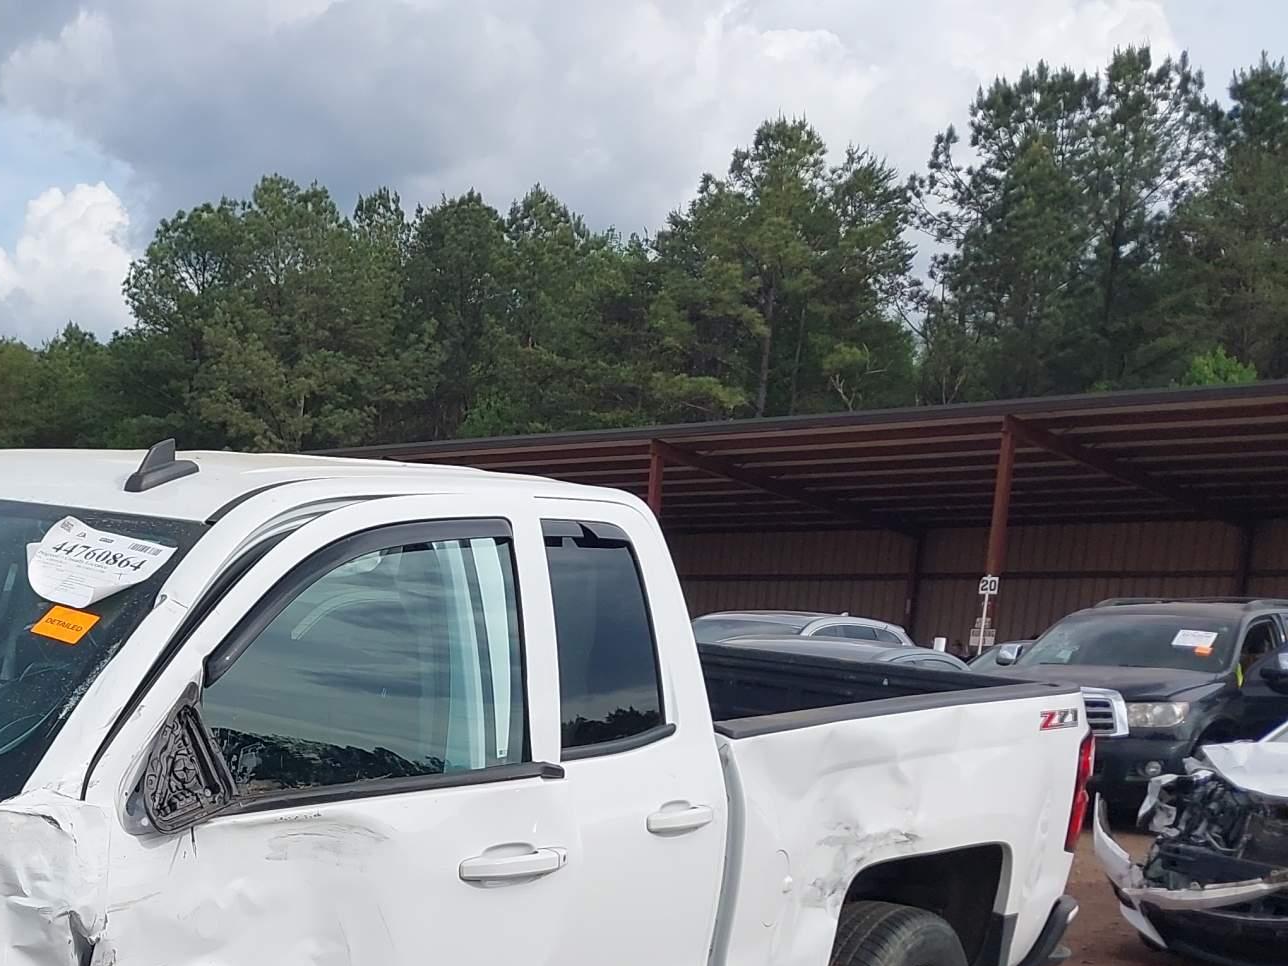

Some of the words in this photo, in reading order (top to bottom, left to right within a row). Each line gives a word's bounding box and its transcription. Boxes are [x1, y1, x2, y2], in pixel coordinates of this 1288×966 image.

[53, 541, 147, 571] 44760864
[981, 580, 997, 591] 20
[45, 617, 83, 632] DETAILED
[1040, 709, 1078, 731] Z71
